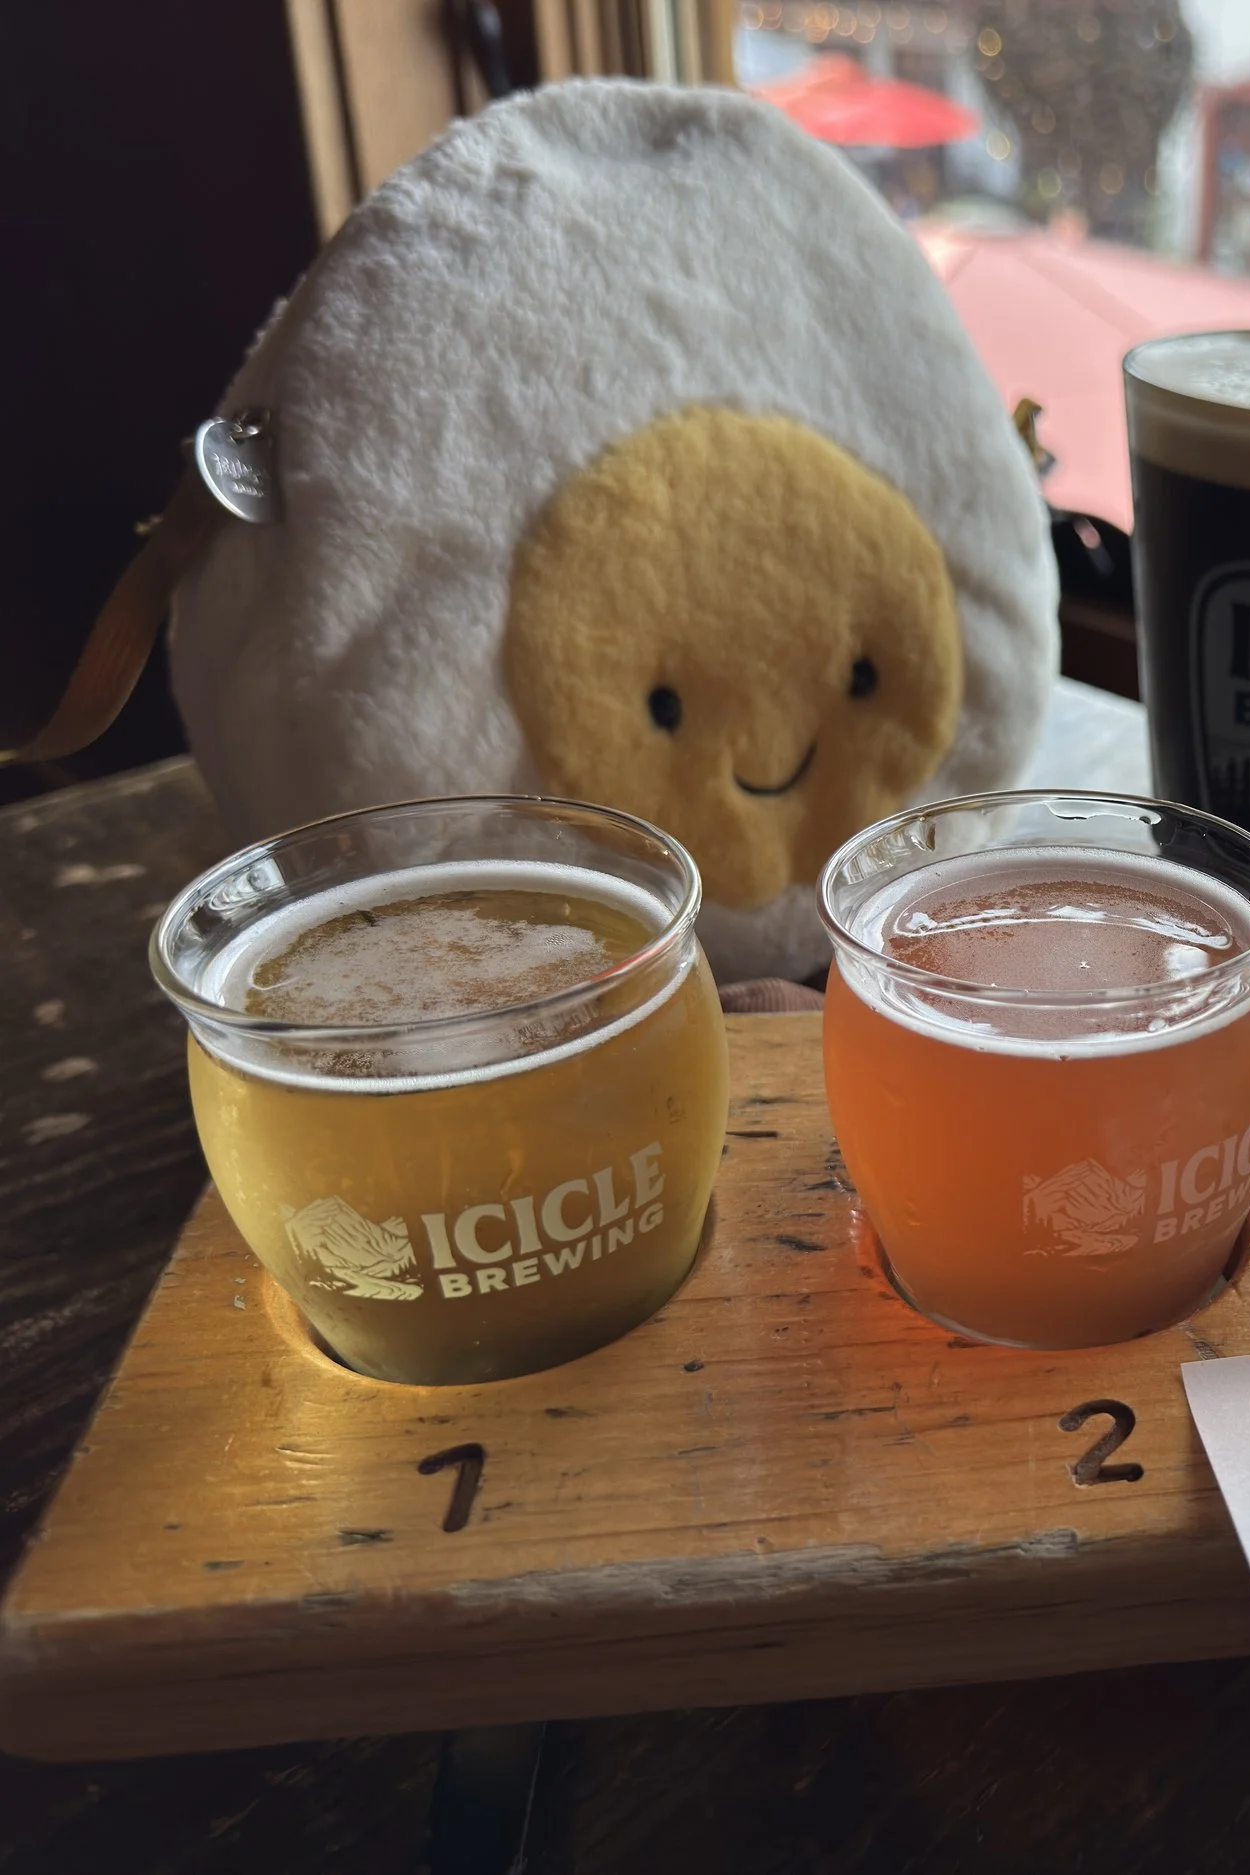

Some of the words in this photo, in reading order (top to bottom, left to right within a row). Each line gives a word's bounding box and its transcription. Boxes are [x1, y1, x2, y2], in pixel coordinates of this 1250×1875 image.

[421, 1140, 666, 1270] ICICLE
[438, 1202, 664, 1299] BREWING
[1058, 1399, 1144, 1486] 2
